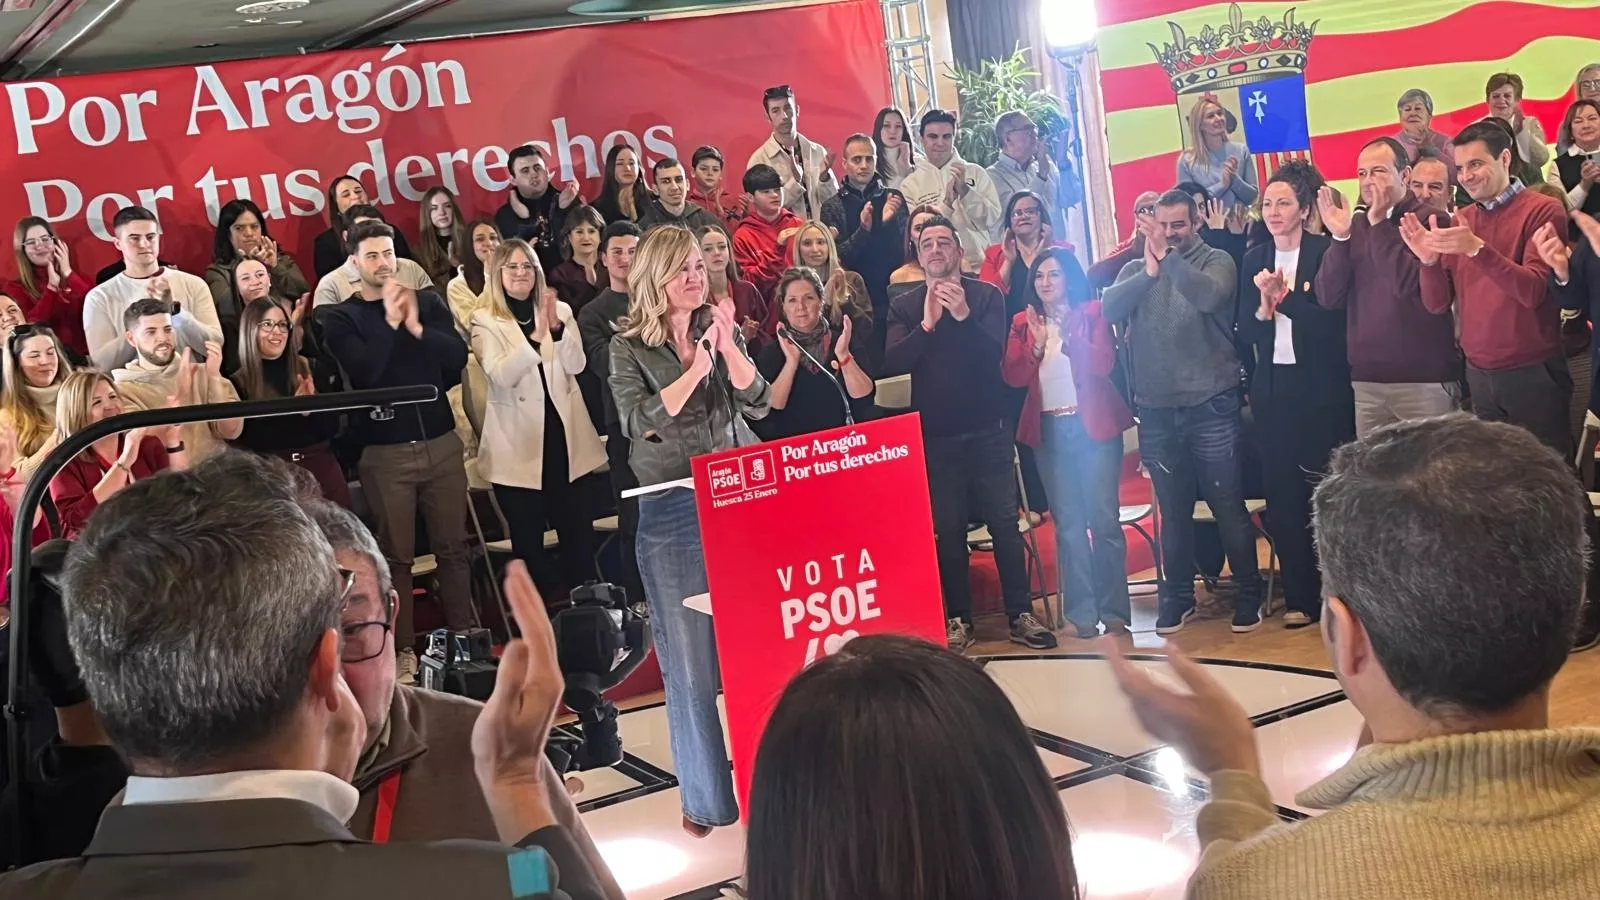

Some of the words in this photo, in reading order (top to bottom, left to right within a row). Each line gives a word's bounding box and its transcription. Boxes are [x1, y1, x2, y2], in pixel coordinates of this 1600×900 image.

[5, 81, 157, 154] Por
[186, 44, 471, 134] Aragón
[24, 178, 173, 242] Por
[194, 166, 326, 228] tus
[781, 445, 809, 462] Por
[812, 430, 867, 456] Aragón
[784, 465, 811, 482] Por
[813, 460, 838, 475] tus
[840, 444, 909, 470] derechos
[712, 467, 732, 478] Aragón
[713, 473, 741, 490] PSOE
[713, 496, 743, 508] Huesca
[743, 491, 753, 501] 25
[754, 488, 778, 499] Enero
[776, 548, 875, 592] VOTA
[780, 579, 881, 640] PSOE
